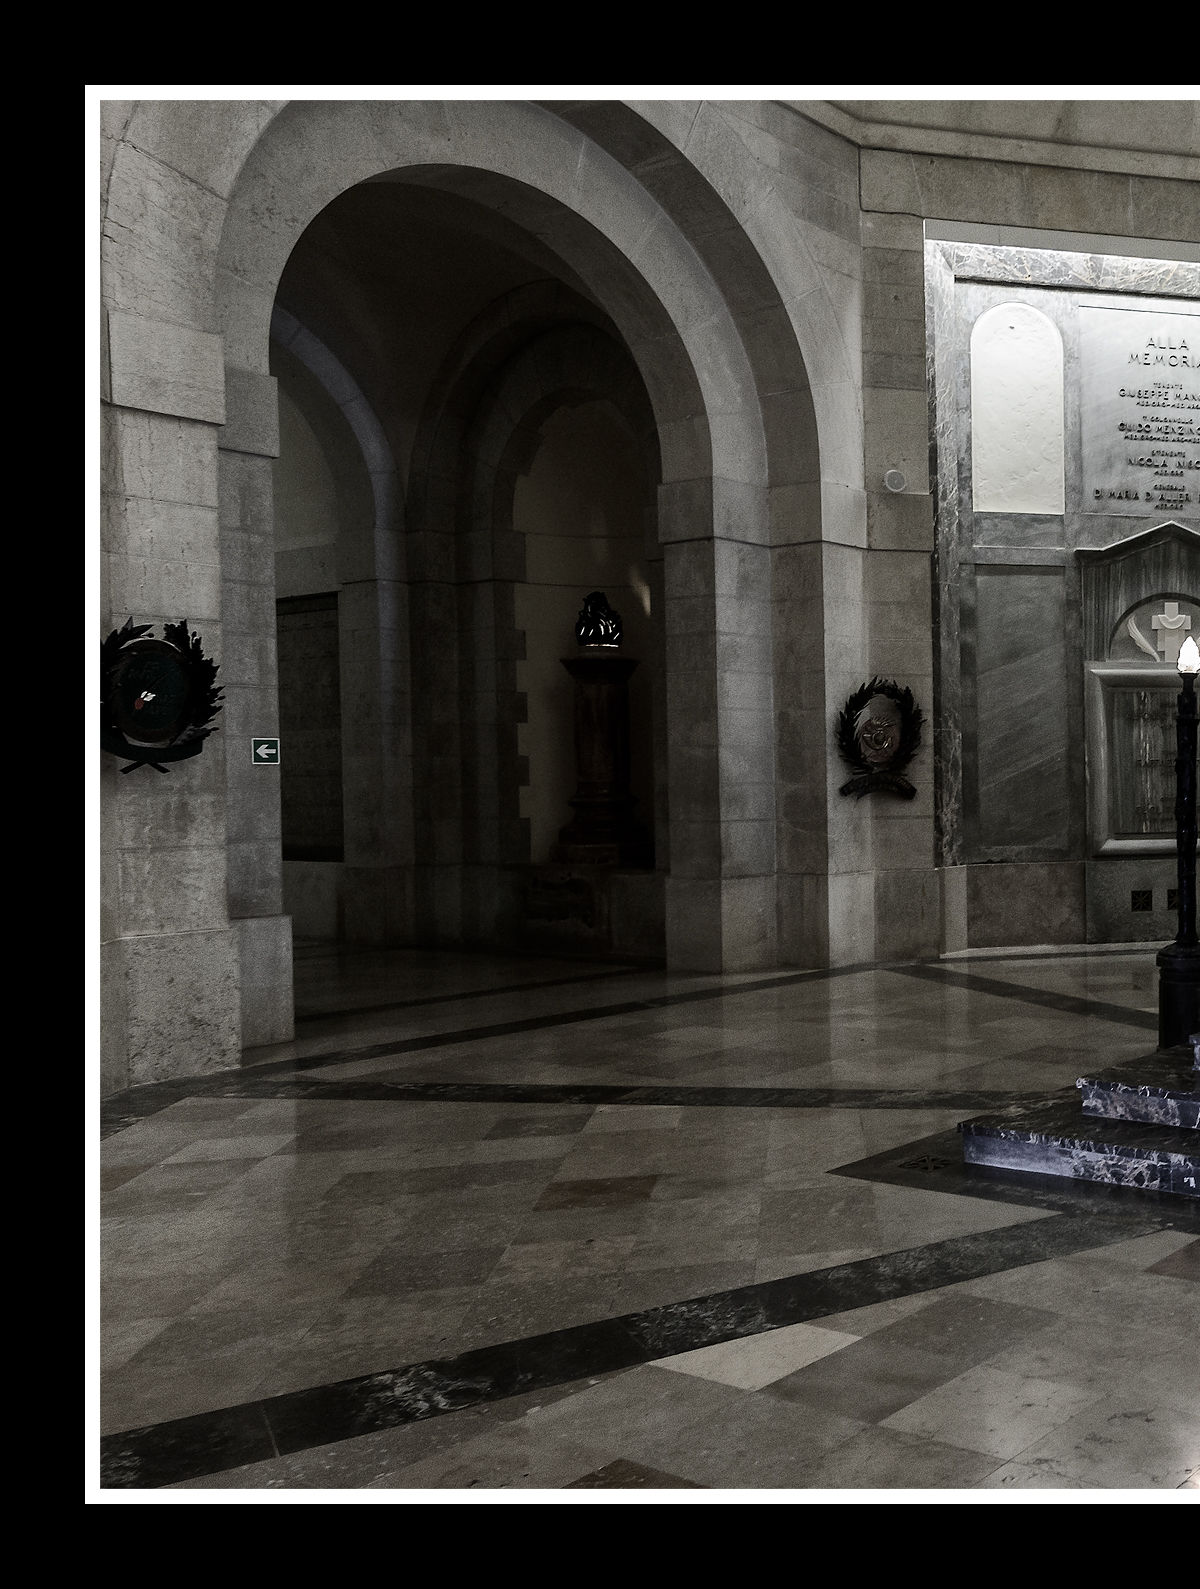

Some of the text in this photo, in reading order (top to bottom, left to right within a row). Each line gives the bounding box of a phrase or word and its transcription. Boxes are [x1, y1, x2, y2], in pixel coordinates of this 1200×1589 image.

[1146, 337, 1189, 350] ALLA
[1119, 388, 1169, 401] GIUSEPPE
[1118, 422, 1151, 433] GUIDO
[1127, 457, 1168, 468] NICOLA
